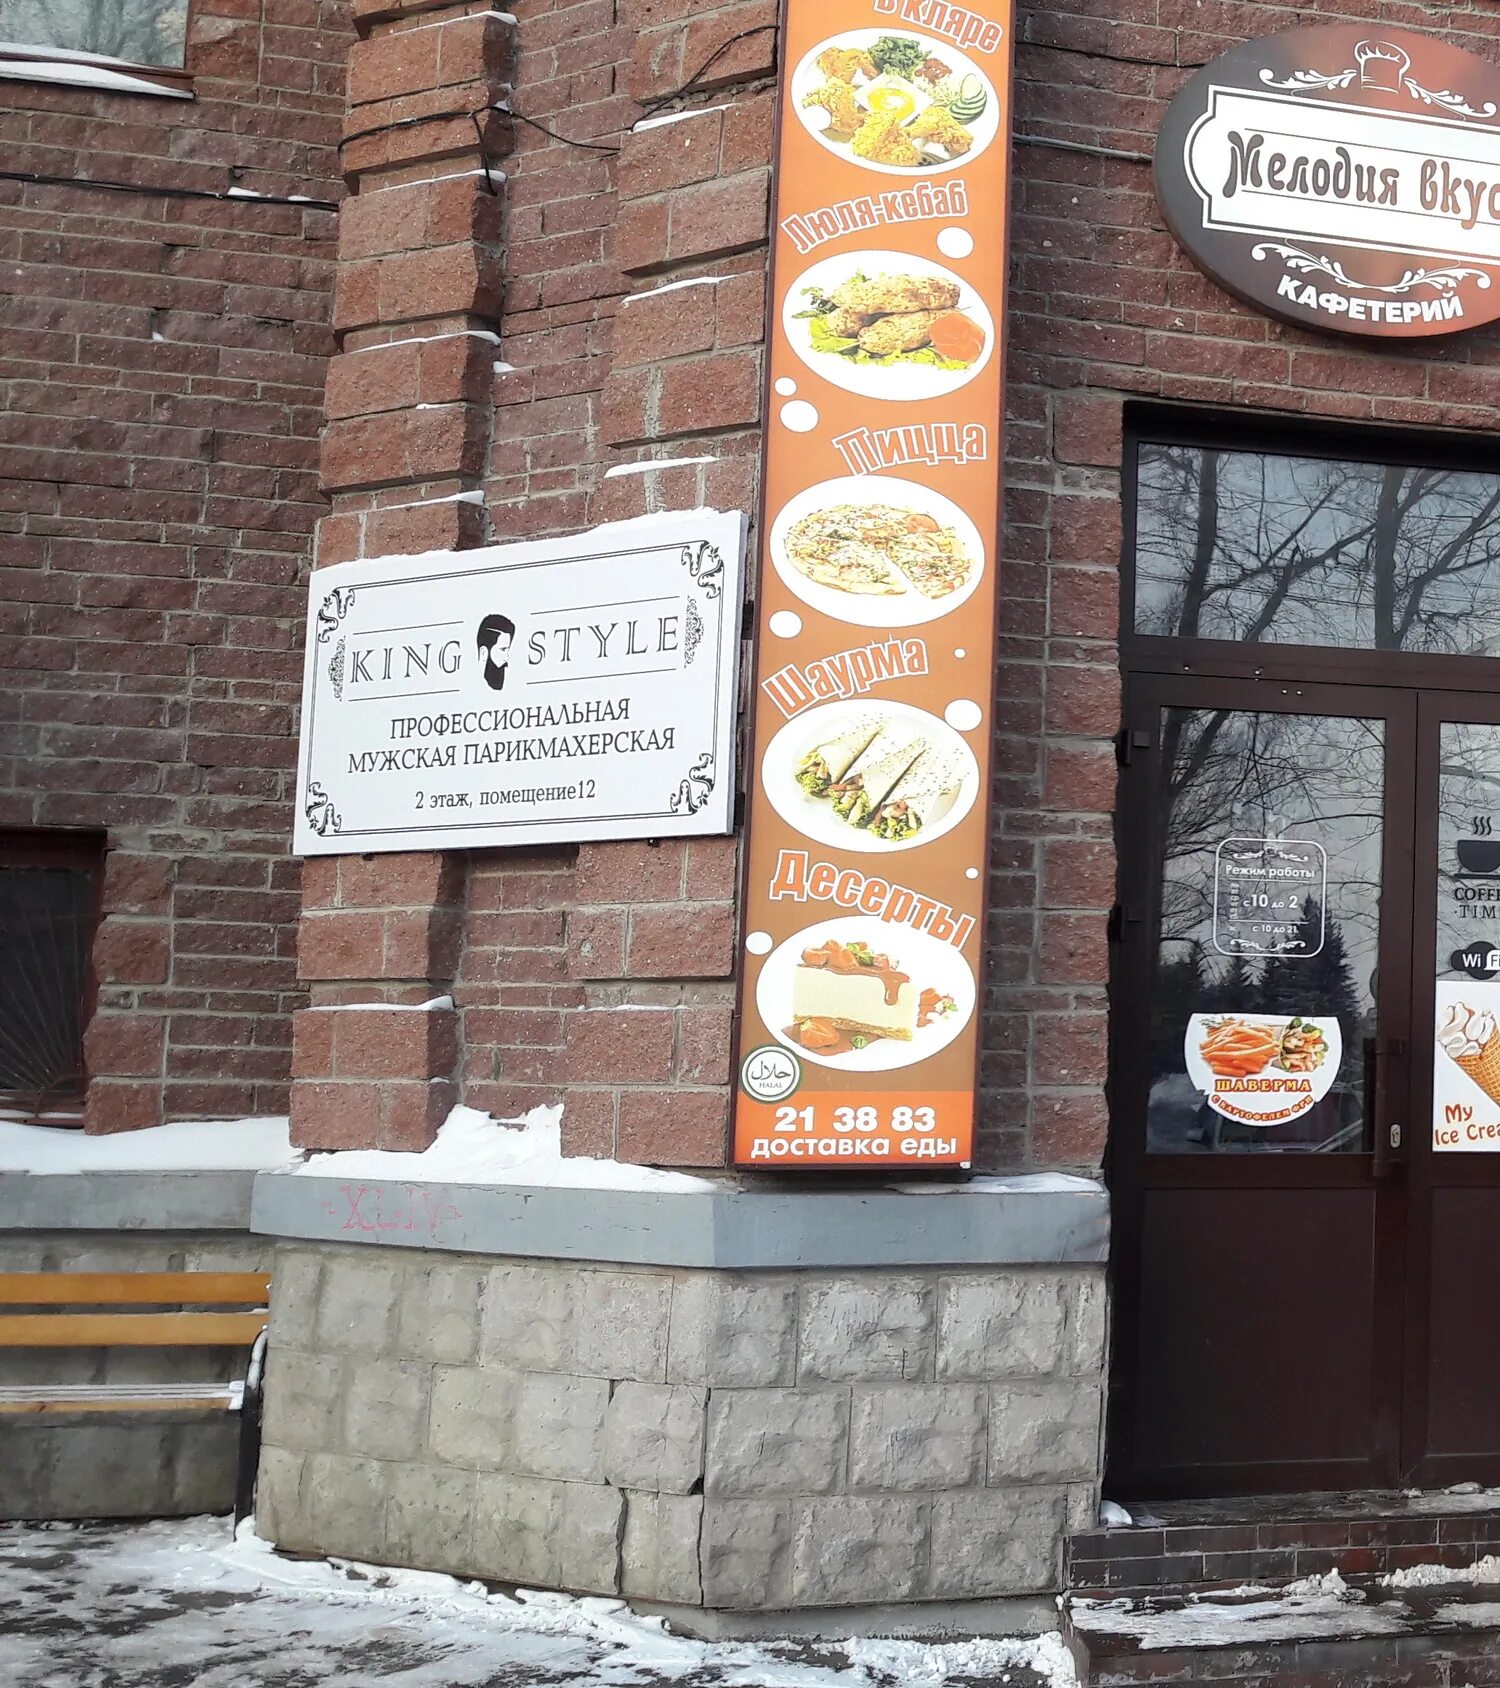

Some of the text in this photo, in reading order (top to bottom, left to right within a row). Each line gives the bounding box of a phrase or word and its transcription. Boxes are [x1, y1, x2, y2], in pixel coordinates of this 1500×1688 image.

[901, 0, 1003, 54] кляре
[1221, 131, 1400, 207] Мелодия
[781, 180, 969, 254] Люля-кебаб
[1276, 274, 1464, 324] КАФЕТЕРИЙ
[832, 422, 988, 476] Пицца
[350, 615, 679, 683] KING STYLE
[761, 635, 929, 720] Шаурма
[390, 698, 630, 740] ПРОФЕССИОНАЛЬНАЯ
[348, 727, 676, 774] МУЖСКАЯ ПАРИКМАХЕРСКАЯ
[415, 791, 424, 809] 2
[430, 792, 473, 809] этаж,
[1225, 865, 1315, 878] Режим работы
[769, 849, 977, 950] Десерты
[1251, 894, 1269, 908] 10
[1262, 925, 1271, 933] 10
[751, 1060, 792, 1081] حلال
[1215, 1079, 1312, 1092] ШАВЕРМА
[774, 1105, 936, 1132] 21 38 83
[1444, 1103, 1473, 1124] My
[751, 1137, 957, 1158] доставка еды
[1434, 1129, 1460, 1146] Ice
